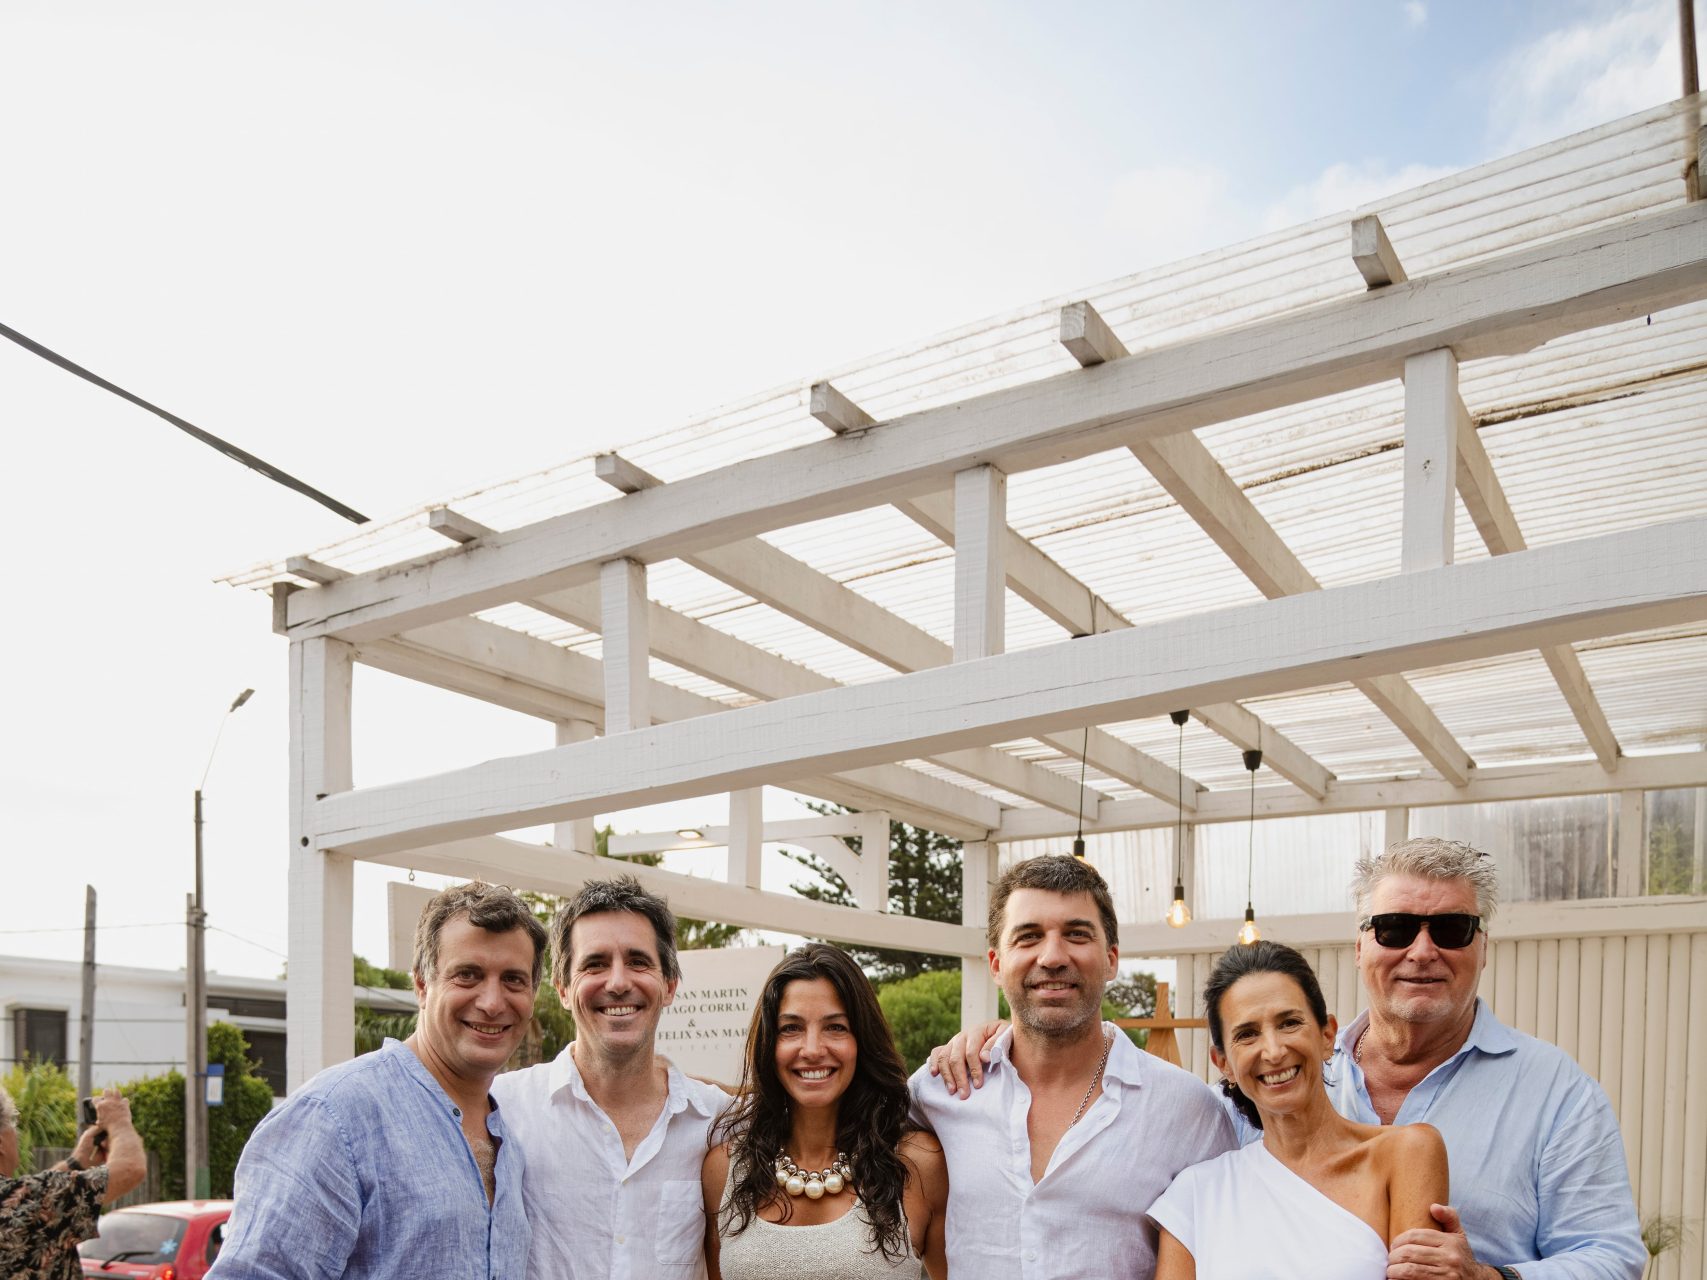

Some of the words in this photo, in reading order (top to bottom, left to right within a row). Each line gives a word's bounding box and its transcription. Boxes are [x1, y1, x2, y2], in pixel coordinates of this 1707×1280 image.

[675, 990, 697, 1000] SAN
[701, 988, 748, 999] MARTIN
[700, 1002, 749, 1014] CORRAL
[688, 1018, 696, 1028] &
[658, 1030, 692, 1040] FELIX
[696, 1029, 718, 1039] SAN
